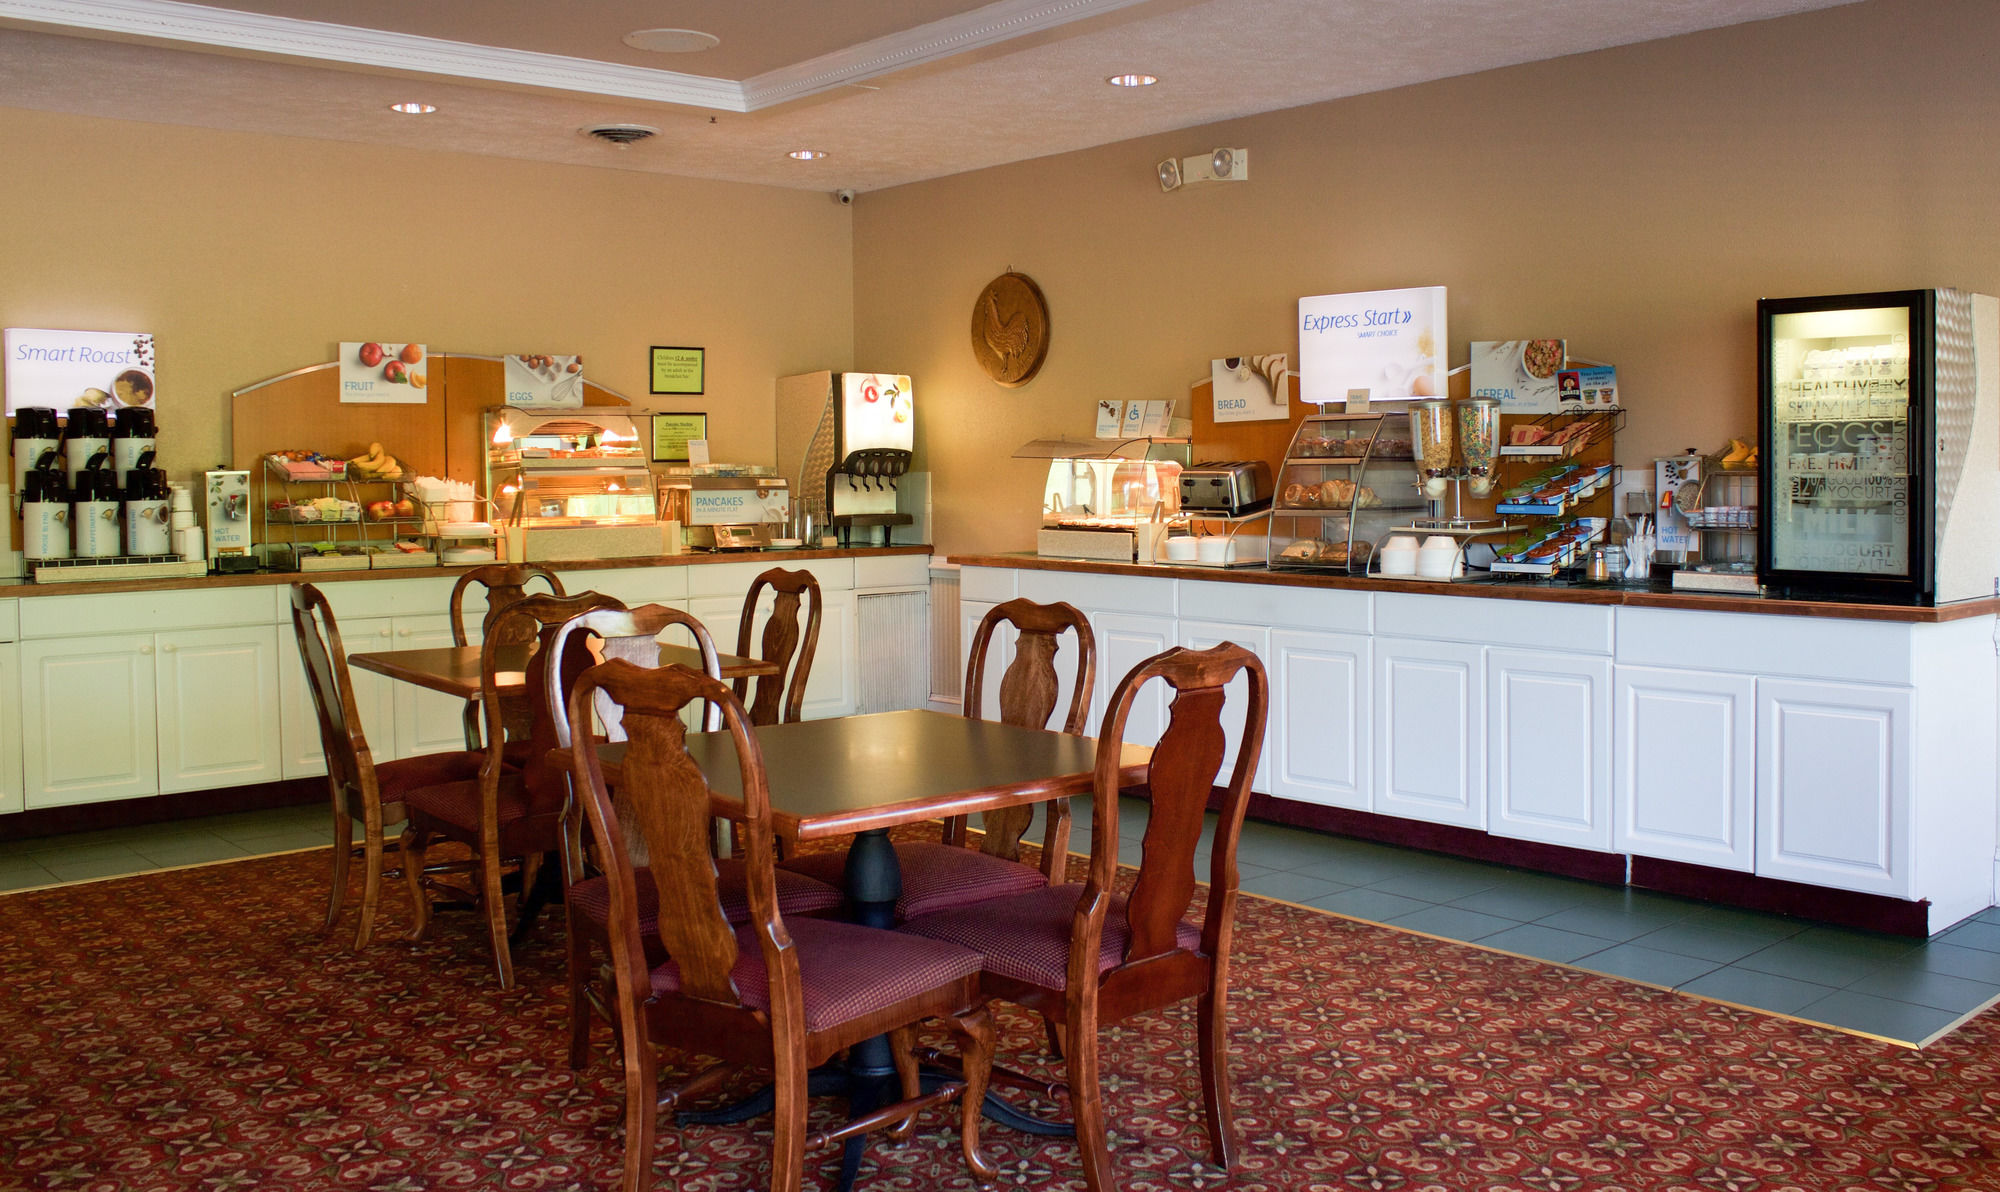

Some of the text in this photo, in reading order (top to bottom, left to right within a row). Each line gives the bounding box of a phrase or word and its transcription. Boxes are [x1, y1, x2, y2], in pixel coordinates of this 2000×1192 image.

[1303, 314, 1359, 334] Express
[16, 344, 131, 364] Smart Roast
[344, 381, 374, 391] FRUIT
[509, 391, 533, 400] EGGS
[1476, 388, 1516, 400] CEREAL
[1217, 398, 1246, 409] BREAD
[1797, 422, 1885, 448] EGGS
[1864, 475, 1893, 486] 100%
[1800, 476, 1826, 497] 2%
[1828, 486, 1893, 498] YOGURT
[695, 496, 744, 506] PANCAKES
[1662, 526, 1678, 534] HOT
